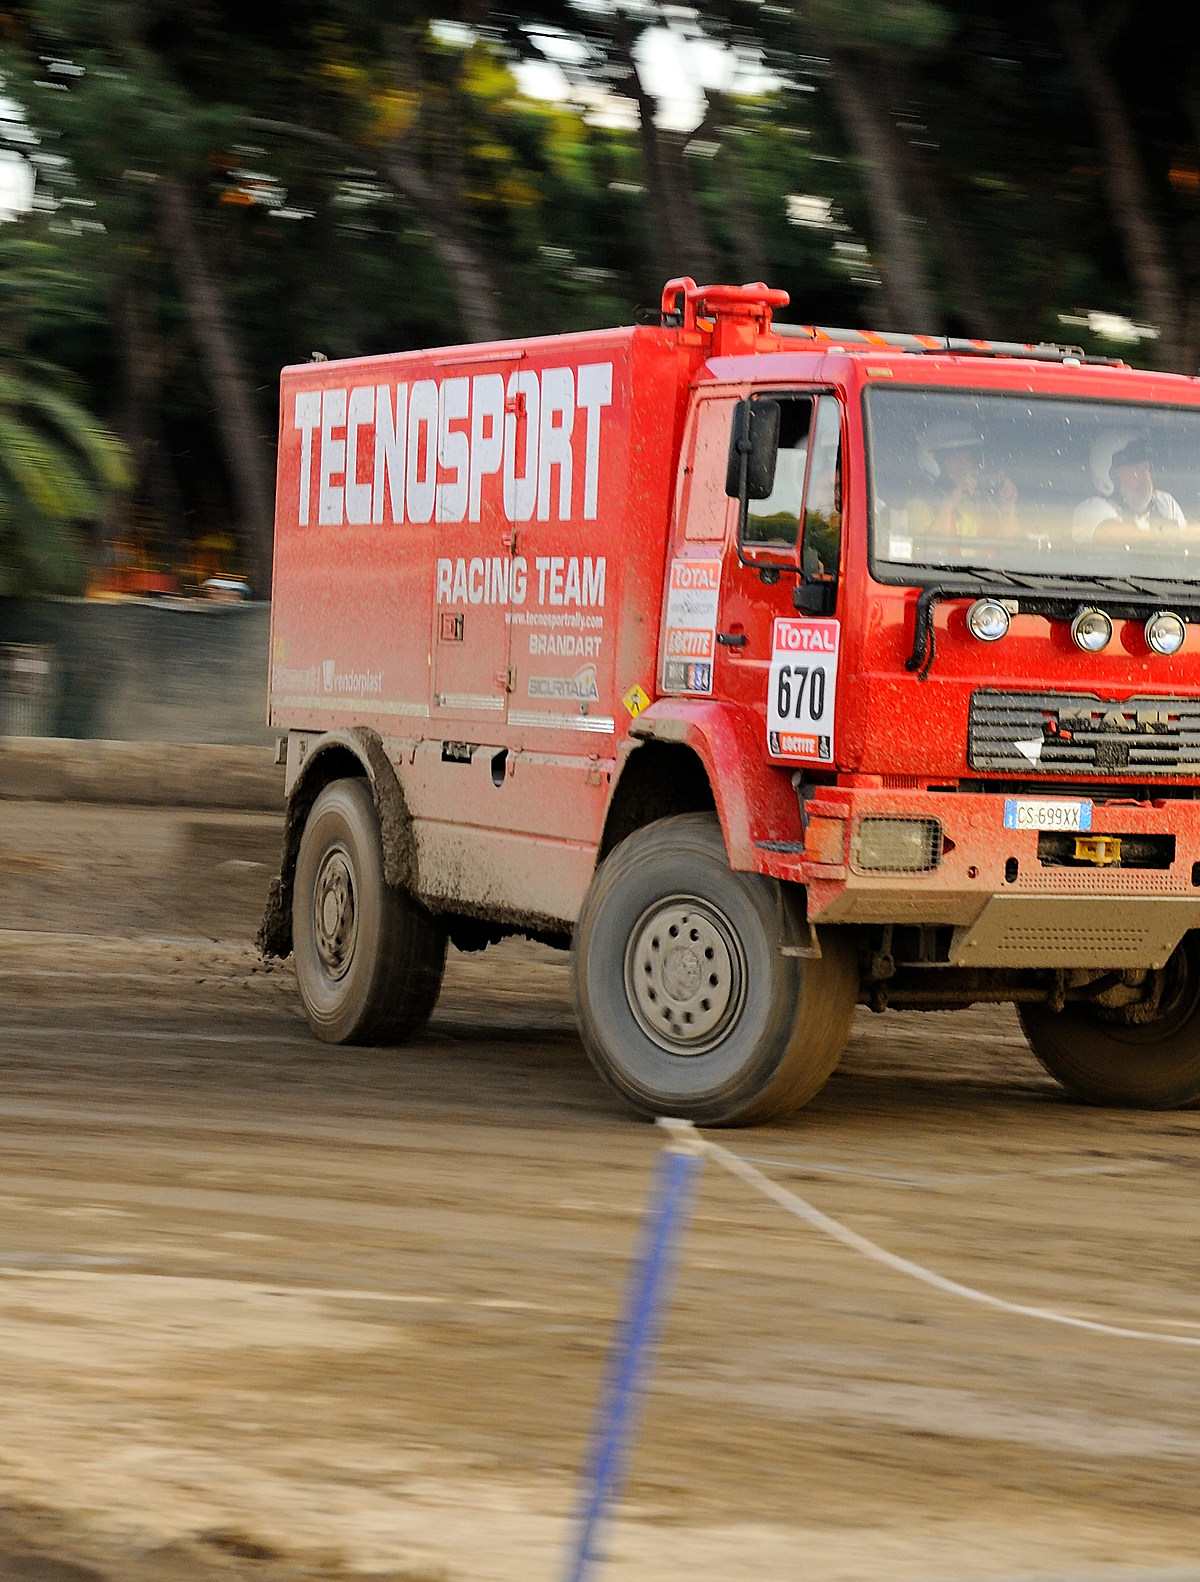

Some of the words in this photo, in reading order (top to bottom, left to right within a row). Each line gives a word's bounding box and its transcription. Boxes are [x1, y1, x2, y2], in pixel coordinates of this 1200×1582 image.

[294, 361, 613, 527] TECNOSPORT
[436, 557, 527, 605] RACING
[535, 556, 606, 607] TEAM
[674, 565, 717, 587] TOTAL
[529, 633, 602, 657] BRANDART
[669, 632, 711, 655] LOCTITE
[778, 623, 834, 650] TOTAL
[777, 665, 826, 721] 670
[782, 735, 816, 754] LOCTITE
[1018, 806, 1034, 824] CS
[1038, 807, 1079, 826] 699XX
